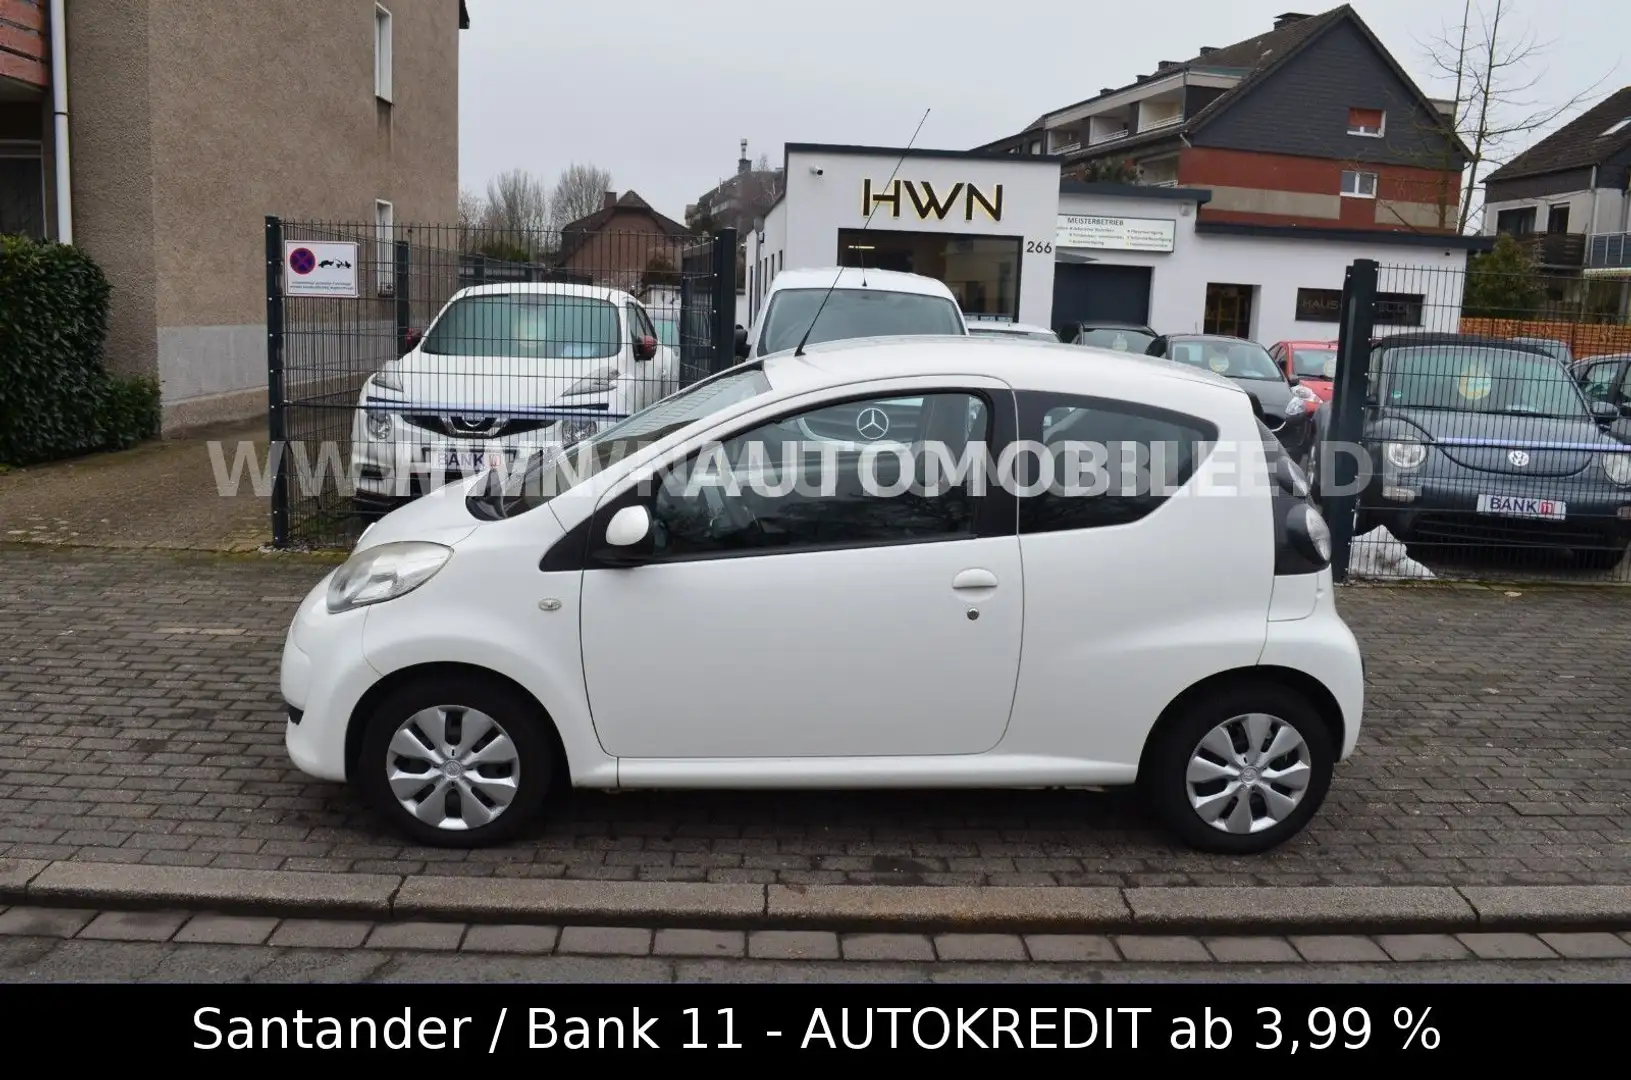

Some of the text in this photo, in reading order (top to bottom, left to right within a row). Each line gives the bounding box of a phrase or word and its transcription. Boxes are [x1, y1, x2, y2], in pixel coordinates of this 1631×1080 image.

[862, 178, 1004, 222] HWN
[1067, 217, 1124, 226] MEISTERBETRIEB
[1026, 240, 1052, 253] 266
